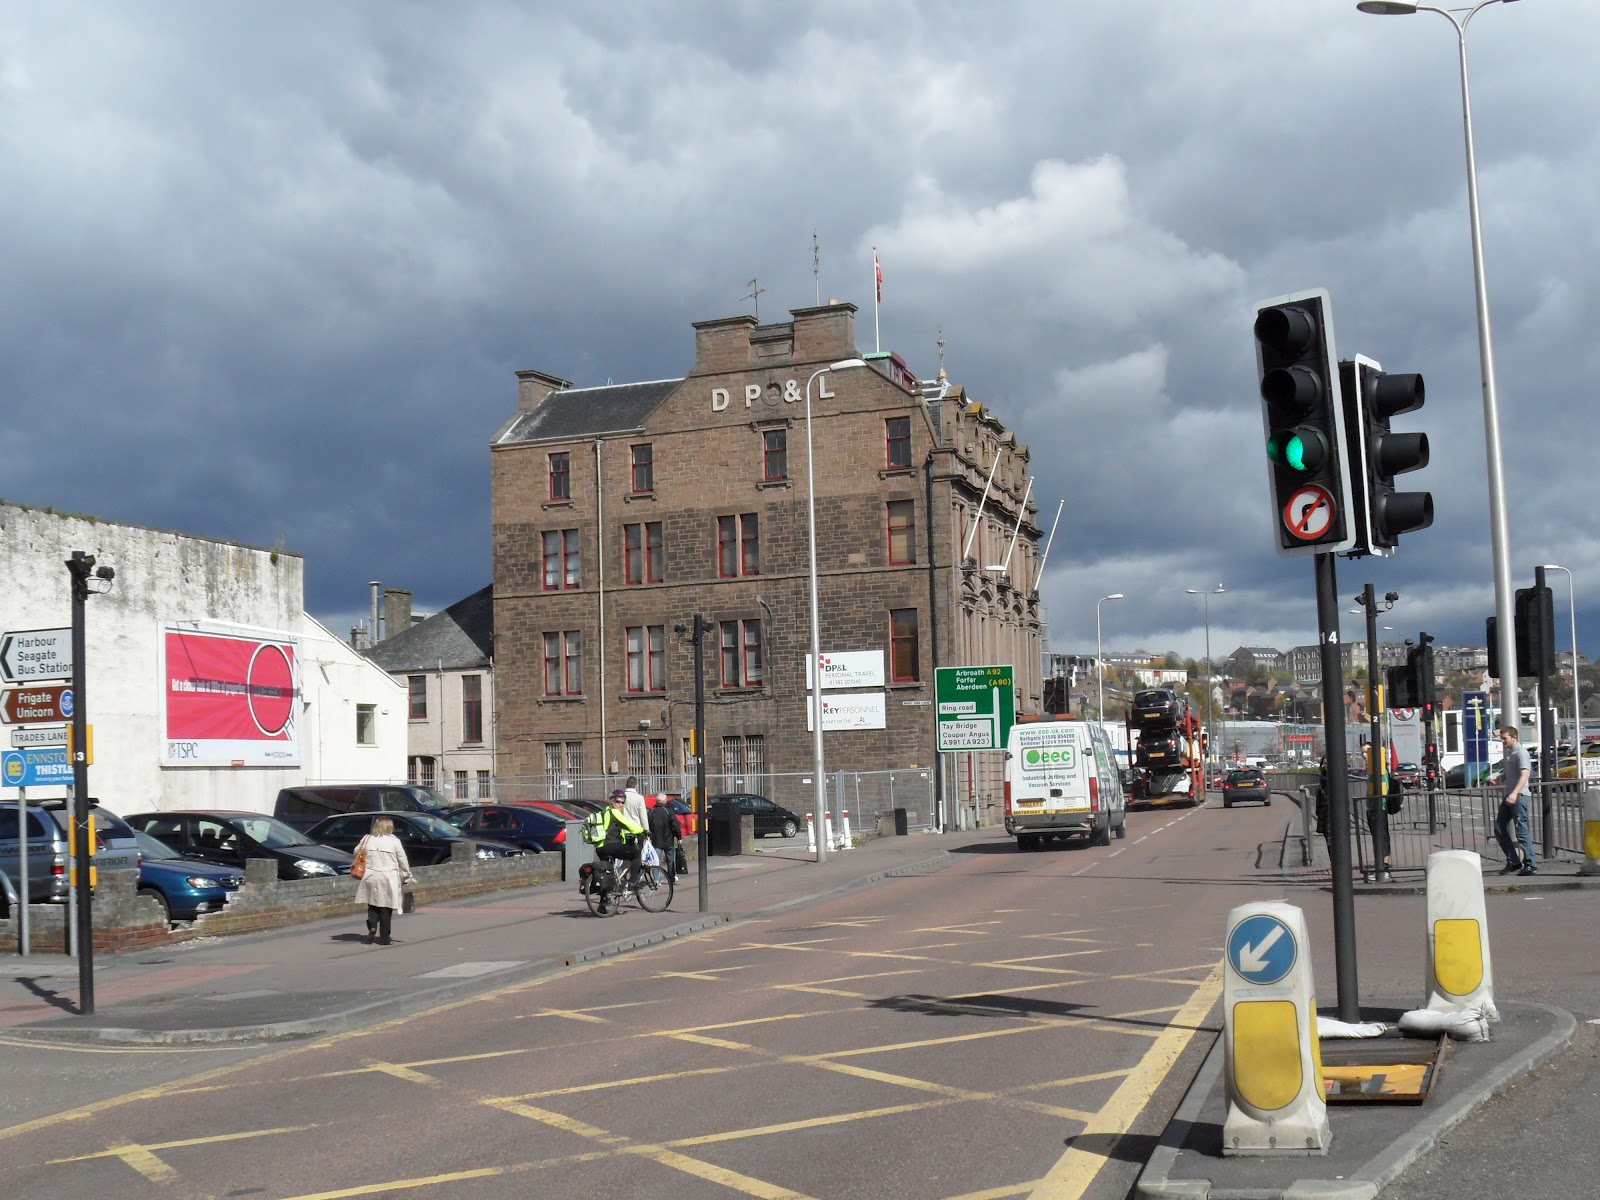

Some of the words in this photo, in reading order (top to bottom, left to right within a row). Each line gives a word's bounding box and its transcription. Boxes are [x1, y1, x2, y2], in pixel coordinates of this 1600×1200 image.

[17, 636, 57, 648] Harbour
[1320, 631, 1338, 645] 14
[17, 649, 57, 662] Seagate
[17, 664, 36, 675] Bus
[825, 664, 847, 672] DP&L
[988, 678, 1012, 686] (A90)
[18, 692, 52, 705] Frigate
[16, 707, 54, 718] Unicorn
[14, 733, 45, 742] TRADES
[47, 731, 68, 740] LANE
[1019, 728, 1075, 736] www.eec.uk.com
[962, 738, 990, 746] (A923)
[176, 742, 199, 759] TSPC
[26, 753, 68, 764] ENNSTO
[1041, 750, 1071, 763] eec
[36, 764, 74, 775] THISTLE
[1, 845, 46, 854] WARIOR
[91, 856, 129, 867] ARRIOR
